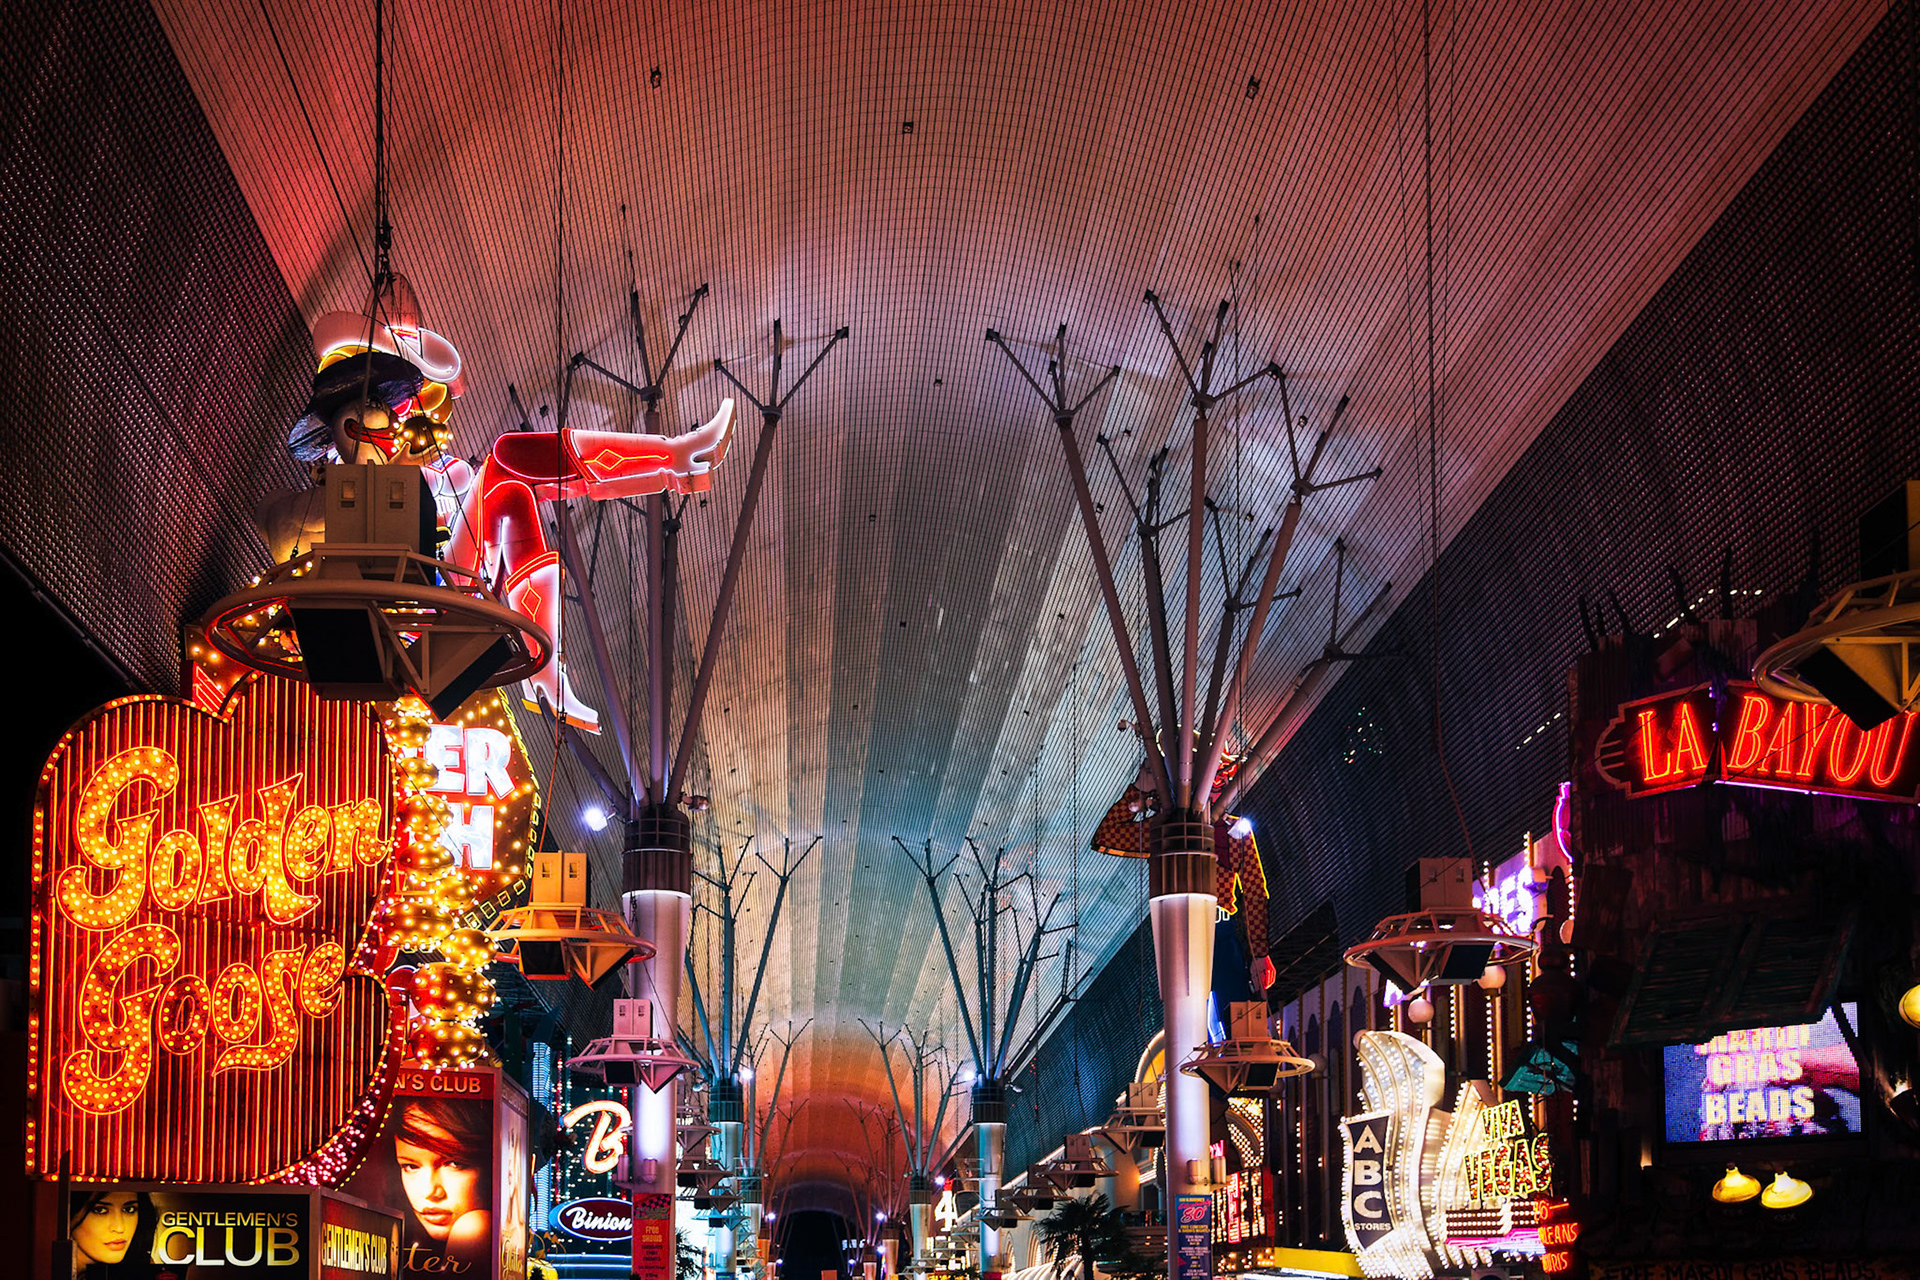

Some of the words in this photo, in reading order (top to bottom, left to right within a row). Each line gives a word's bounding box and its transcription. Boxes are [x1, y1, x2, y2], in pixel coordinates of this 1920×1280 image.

[1638, 702, 1707, 781] LA
[1727, 694, 1919, 788] BAYOU
[56, 746, 393, 932] Golden
[62, 923, 345, 1115] Goose
[430, 1076, 481, 1093] CLUB
[1710, 1050, 1803, 1085] GRAS
[1481, 1099, 1525, 1142] VIVA
[1705, 1086, 1815, 1125] BEADS
[562, 1100, 632, 1174] B
[1464, 1132, 1552, 1201] VEGAS
[161, 1211, 299, 1228] GENTLEMEN'S
[565, 1206, 632, 1231] Binion
[1354, 1222, 1391, 1231] STORES
[157, 1227, 300, 1267] CLUB
[321, 1222, 370, 1273] GENTLEMEN'S
[371, 1232, 387, 1275] CLUB
[1664, 1261, 1735, 1280] MARDI
[1744, 1261, 1797, 1280] GRAS
[1806, 1260, 1876, 1280] BEADS
